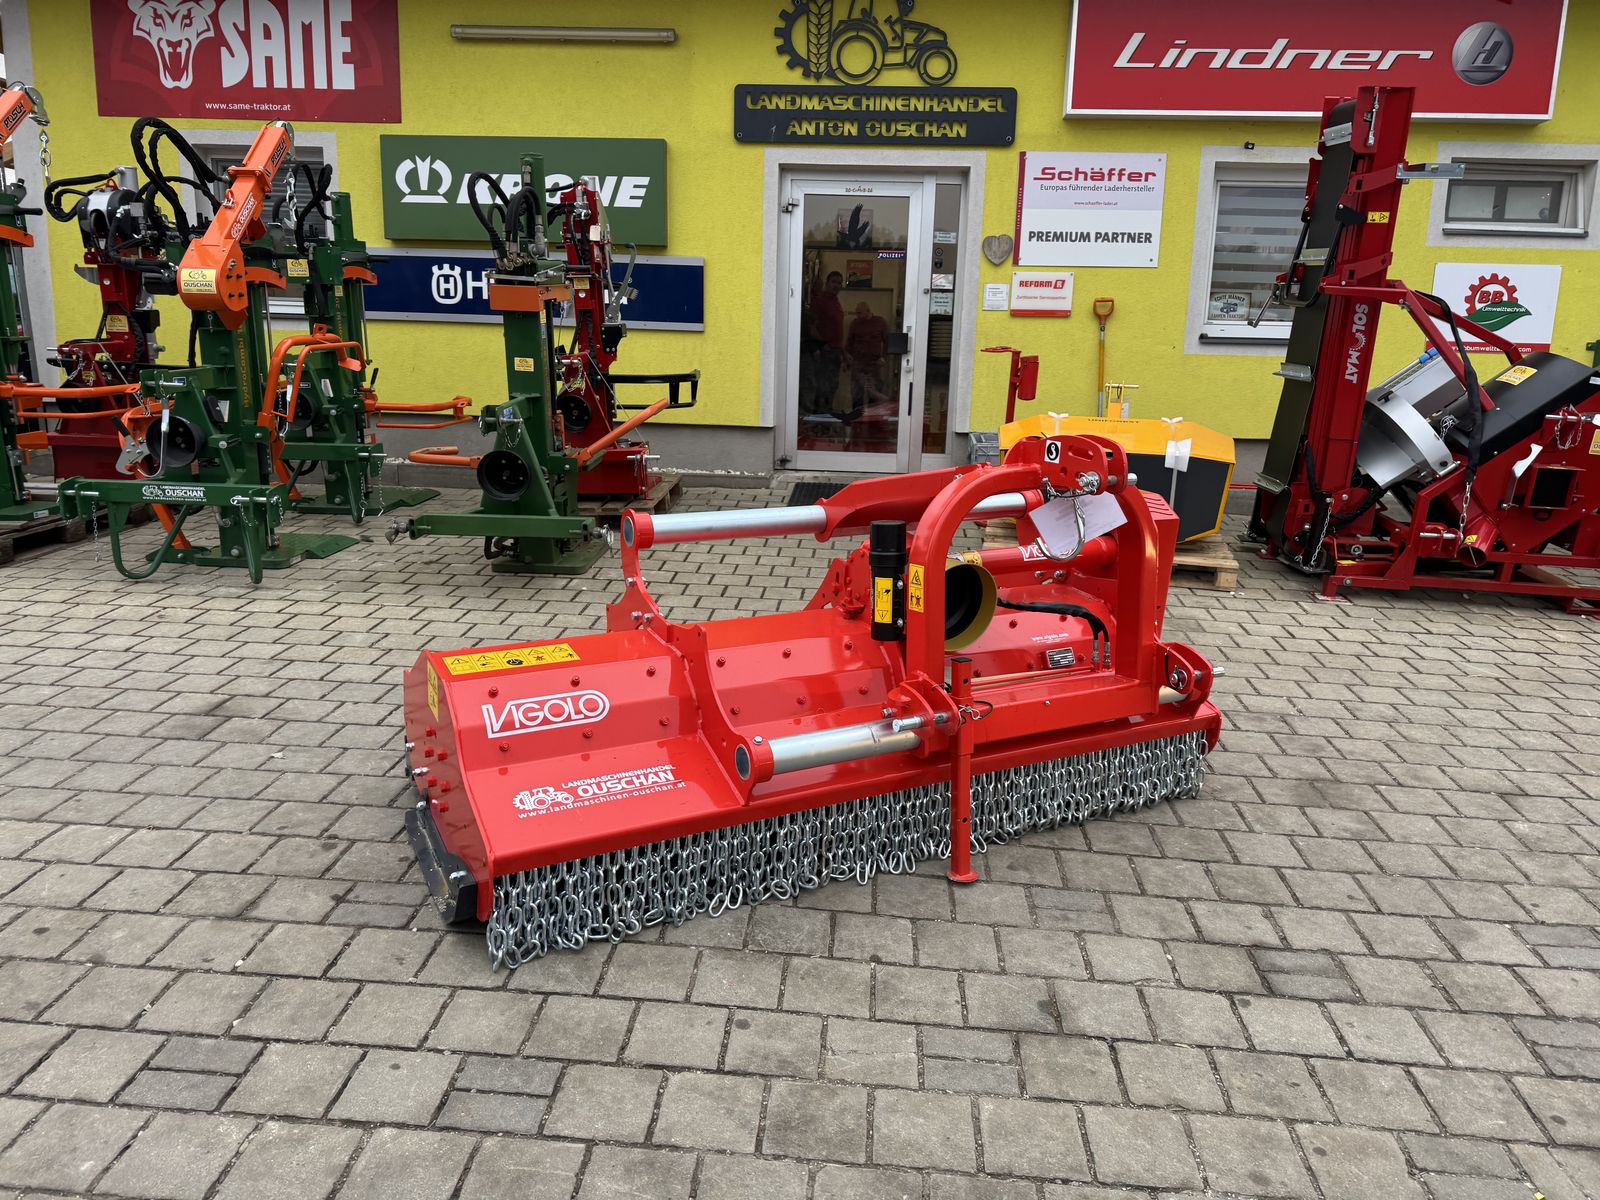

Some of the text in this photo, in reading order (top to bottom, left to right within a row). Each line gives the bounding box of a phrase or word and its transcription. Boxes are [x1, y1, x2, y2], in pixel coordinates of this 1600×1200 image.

[218, 0, 356, 90] SAME
[1113, 32, 1434, 71] Lindner
[205, 101, 291, 112] www.same-traktor.at
[745, 92, 1008, 113] LANDMASCHINENHANDEL
[786, 118, 968, 138] ANTON OUSCHAN
[1033, 167, 1157, 182] Schäffer
[1040, 184, 1155, 193] Europas führender Laderhersteller
[1028, 231, 1153, 244] PREMIUM PARTNER
[1019, 280, 1053, 288] REFORM
[1478, 290, 1505, 304] BB
[165, 489, 204, 497] OUSCHAN
[483, 690, 607, 735] VIGOLO
[561, 764, 677, 789] LANDMASCHINENHANDEL
[577, 770, 675, 798] OUSCHAN
[517, 781, 687, 819] www.landmaschinen-ouschan.at
